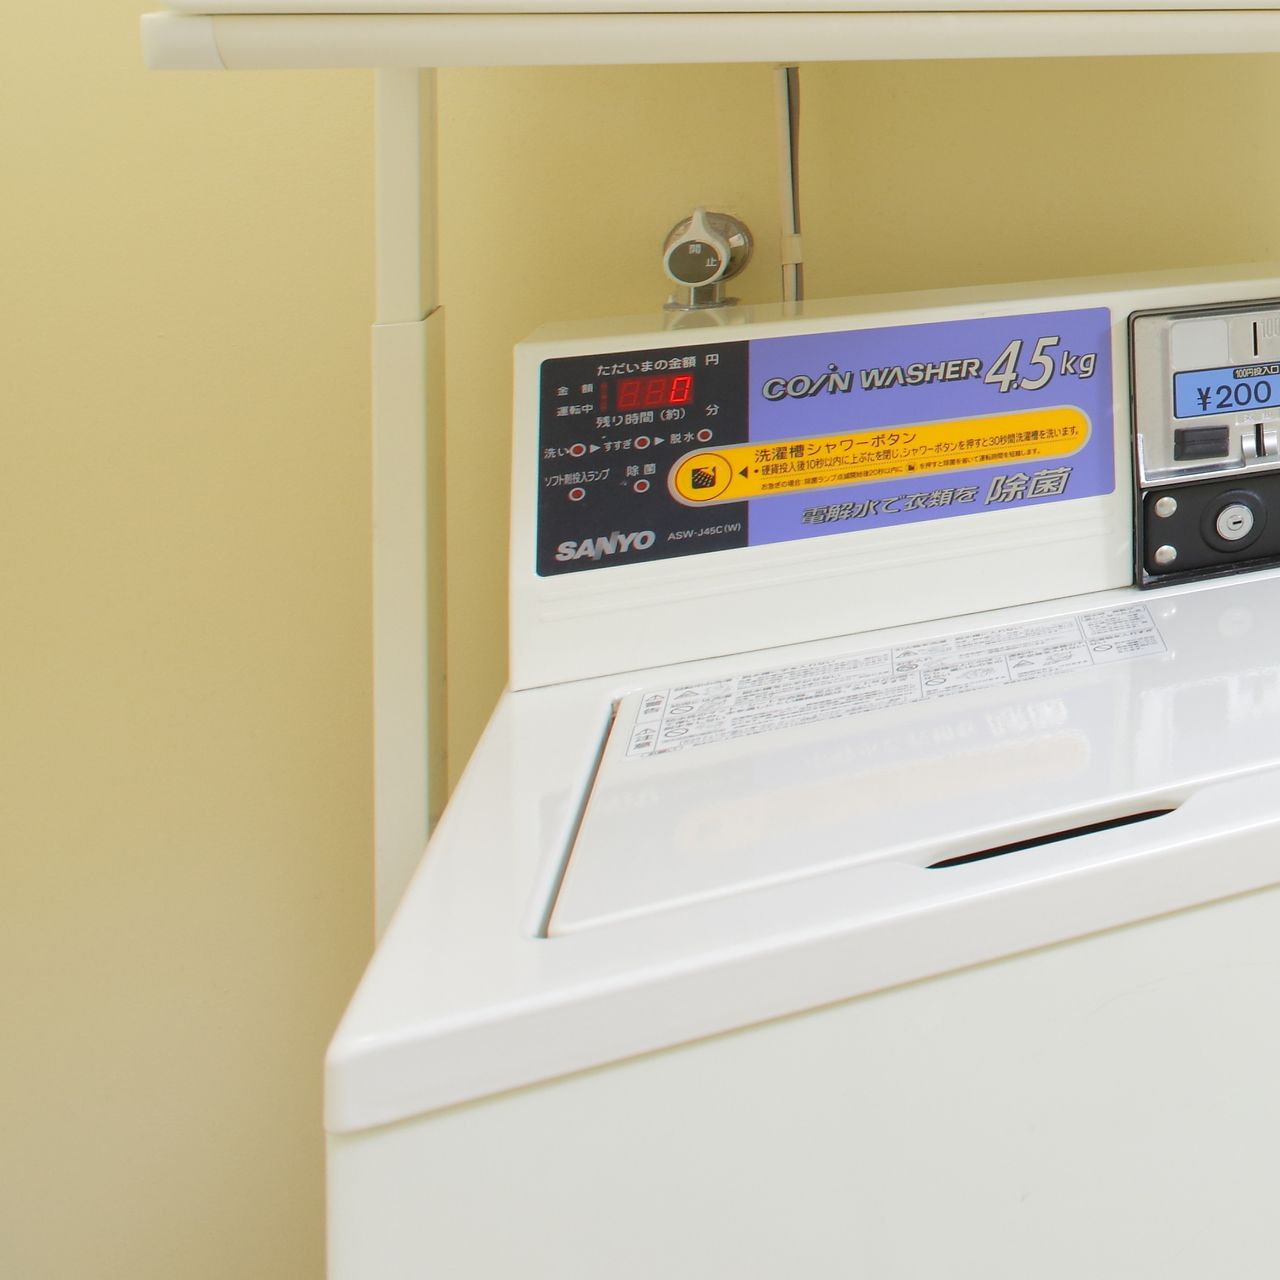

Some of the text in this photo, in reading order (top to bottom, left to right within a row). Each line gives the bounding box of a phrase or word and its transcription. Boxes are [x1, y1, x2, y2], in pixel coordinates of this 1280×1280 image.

[597, 353, 719, 377] ただいまの金額 円
[860, 357, 982, 391] WASHER
[556, 404, 594, 417] 運転中
[706, 404, 720, 417] 分
[1196, 380, 1272, 412] ¥200
[544, 446, 569, 459] 洗い
[603, 438, 632, 451] すすぎ
[755, 432, 917, 463] 洗濯槽シャワーボタン
[802, 466, 1074, 526] 電解水で衣類を 除菌
[555, 530, 656, 562] SANYO
